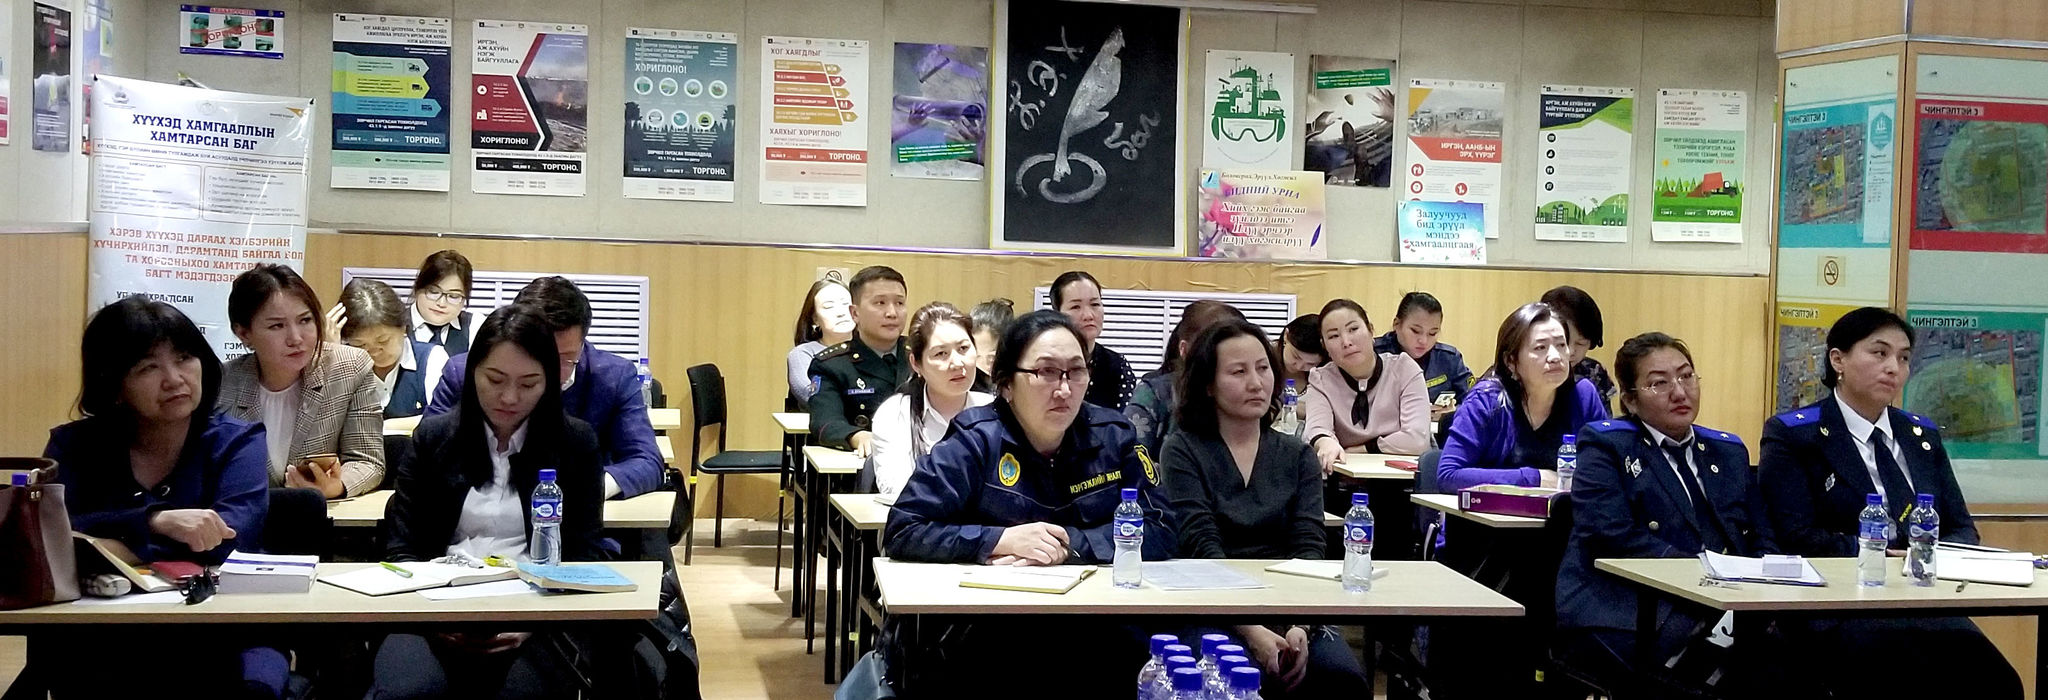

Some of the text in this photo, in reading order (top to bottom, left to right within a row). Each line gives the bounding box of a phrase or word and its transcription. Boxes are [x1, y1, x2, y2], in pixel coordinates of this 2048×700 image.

[635, 63, 687, 74] ХОРИГЛОНО!
[1924, 106, 1972, 115] ЧИНГЭЛТЭЙ
[132, 114, 275, 138] ХҮҮХЭД ХАМГААЛЛЫН
[150, 130, 257, 150] ХАМТАРСАН БАГ
[404, 136, 442, 144] ТОРГОНО.
[480, 136, 528, 145] ХОРИГЛОНО!
[829, 152, 862, 160] ТОРГОНО.
[542, 163, 578, 172] ТОРГОНО.
[692, 166, 727, 176] ТОРГОНО.
[1416, 208, 1467, 220] Залуучууд
[1416, 220, 1434, 229] бид
[110, 227, 290, 247] ХЭРЭВ ХҮҮХЭД ДАРААХ ХЭЛБЭРИЙН
[1410, 240, 1474, 249] хамгаалцгаая
[125, 254, 138, 263] ТА
[242, 249, 282, 259] БАЙГАА
[145, 268, 239, 282] БАГТ МЭДЭГДЭЭР
[1912, 316, 1970, 328] ЧИНГЭЛТЭЙ
